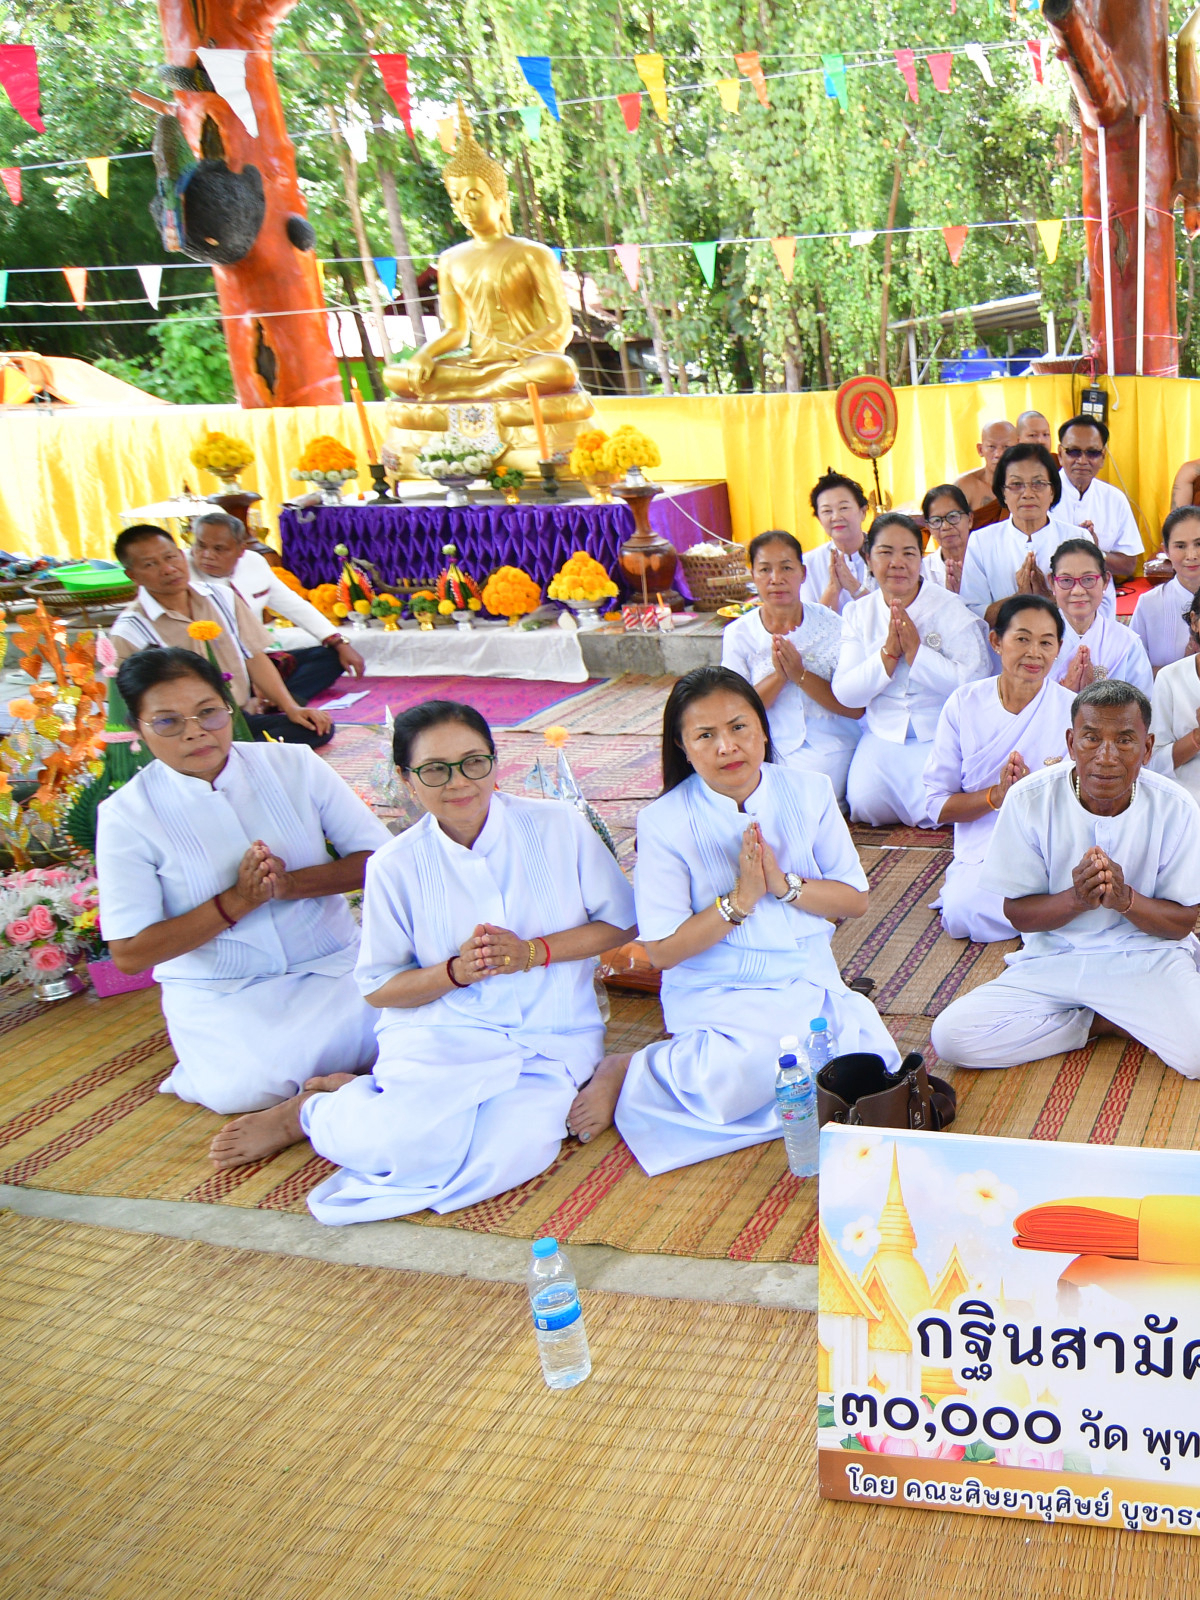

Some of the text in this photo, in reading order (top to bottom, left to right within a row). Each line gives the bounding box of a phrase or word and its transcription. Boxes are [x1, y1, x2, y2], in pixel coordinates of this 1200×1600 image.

[841, 1392, 1062, 1444] ๓๐,๐๐๐
[1079, 1408, 1128, 1451] วัด
[848, 1466, 894, 1495] โดย
[906, 1480, 1110, 1521] คณะศิษยานุศิษย์
